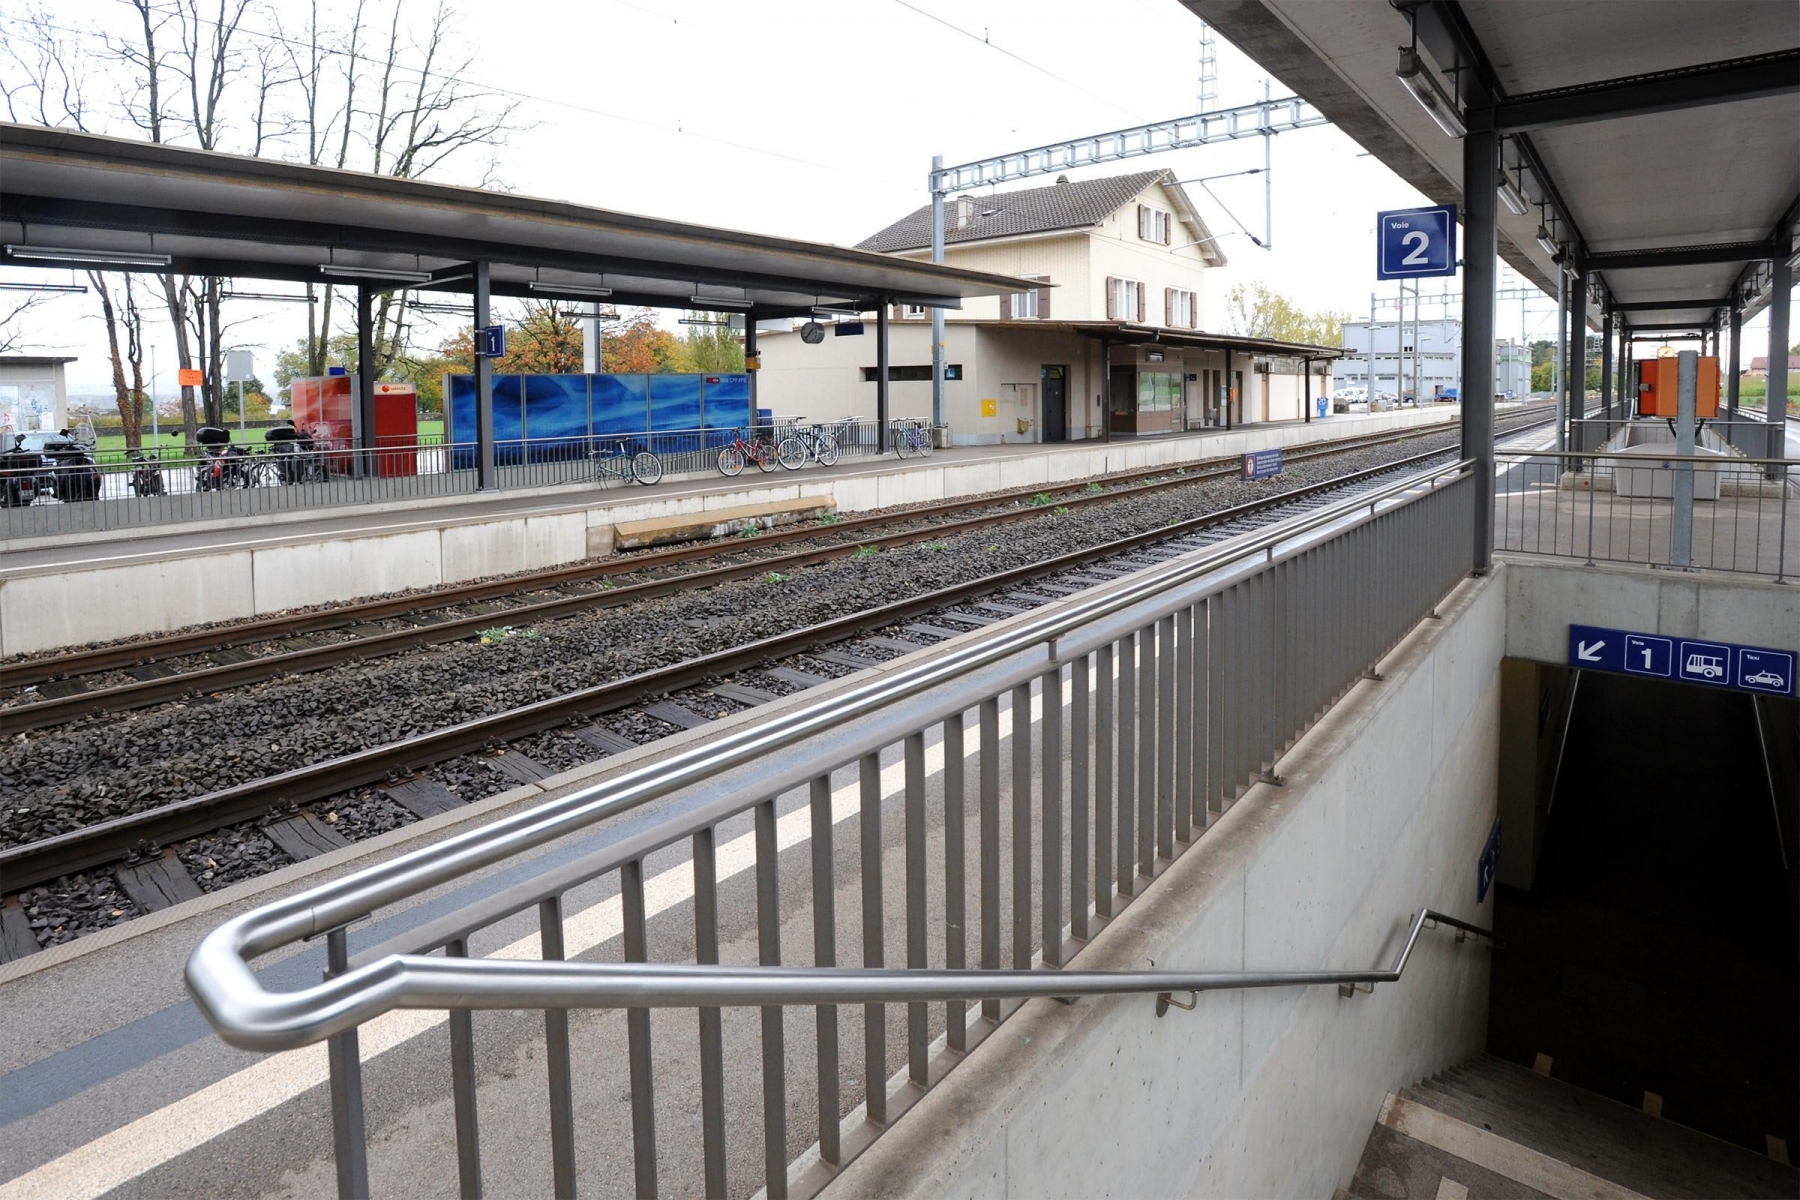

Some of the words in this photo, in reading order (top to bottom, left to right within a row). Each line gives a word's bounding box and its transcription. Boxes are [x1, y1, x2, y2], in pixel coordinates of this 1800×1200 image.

[1402, 231, 1430, 265] 2
[490, 336, 495, 352] 1
[1641, 648, 1652, 669] 1
